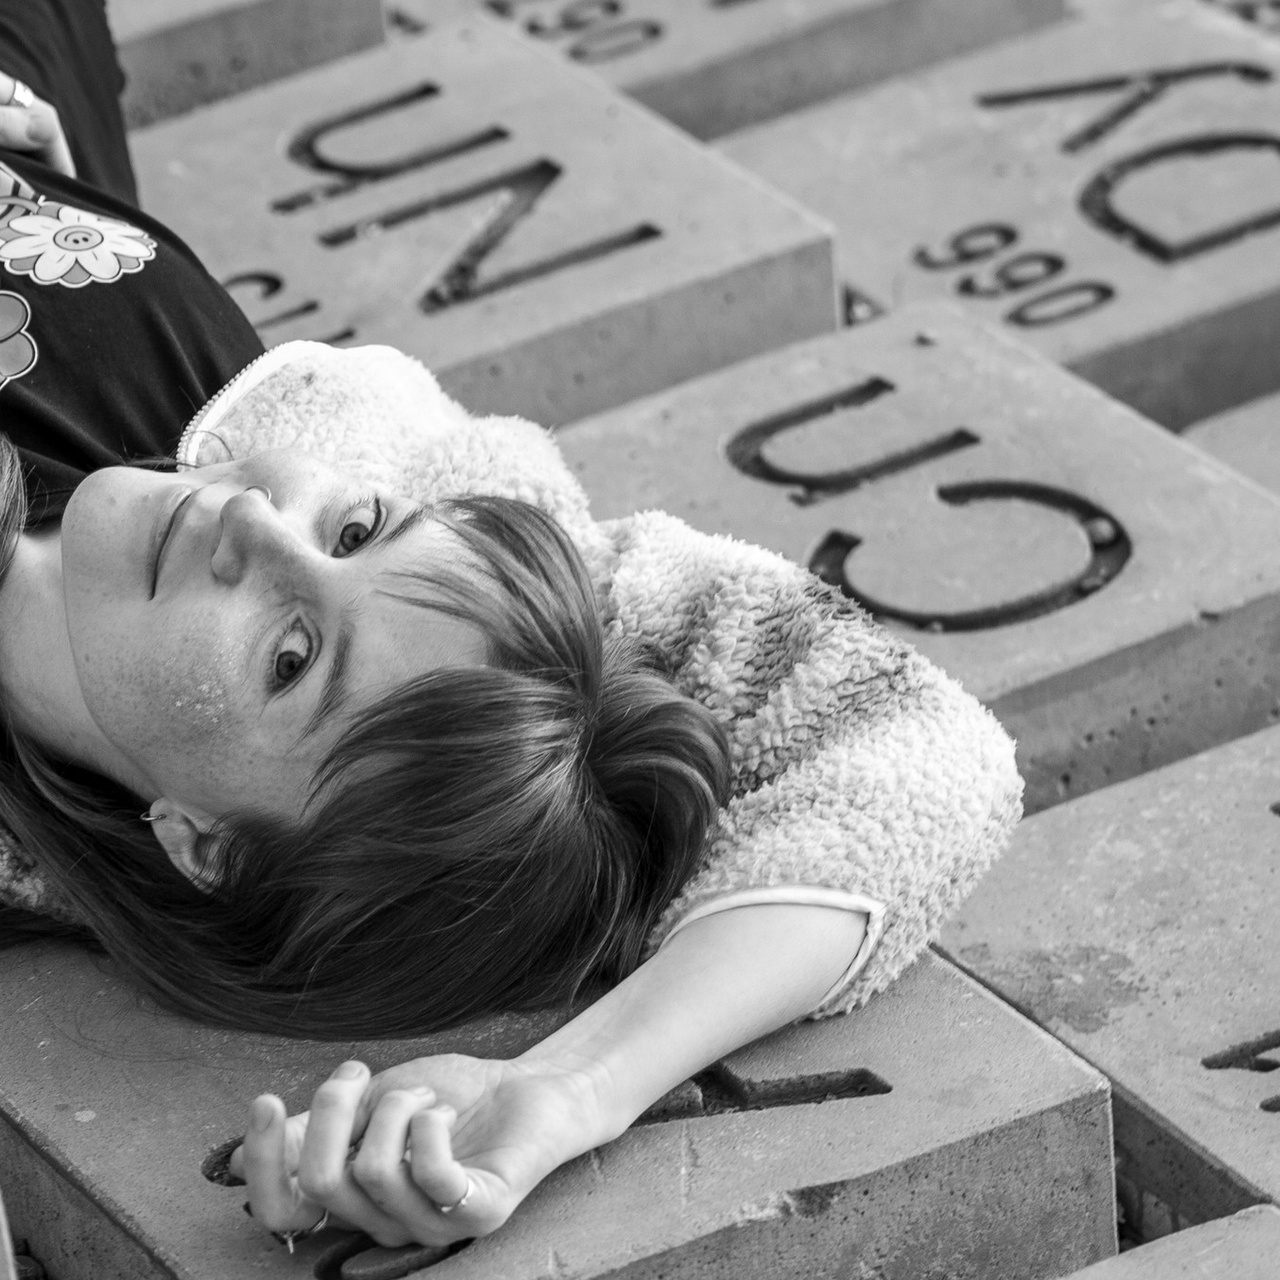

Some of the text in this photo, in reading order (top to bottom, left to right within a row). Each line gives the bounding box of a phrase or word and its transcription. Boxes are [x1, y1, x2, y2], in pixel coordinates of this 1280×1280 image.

[270, 80, 664, 315] Nh
[913, 222, 1116, 328] 066
[725, 376, 1132, 633] Cn
